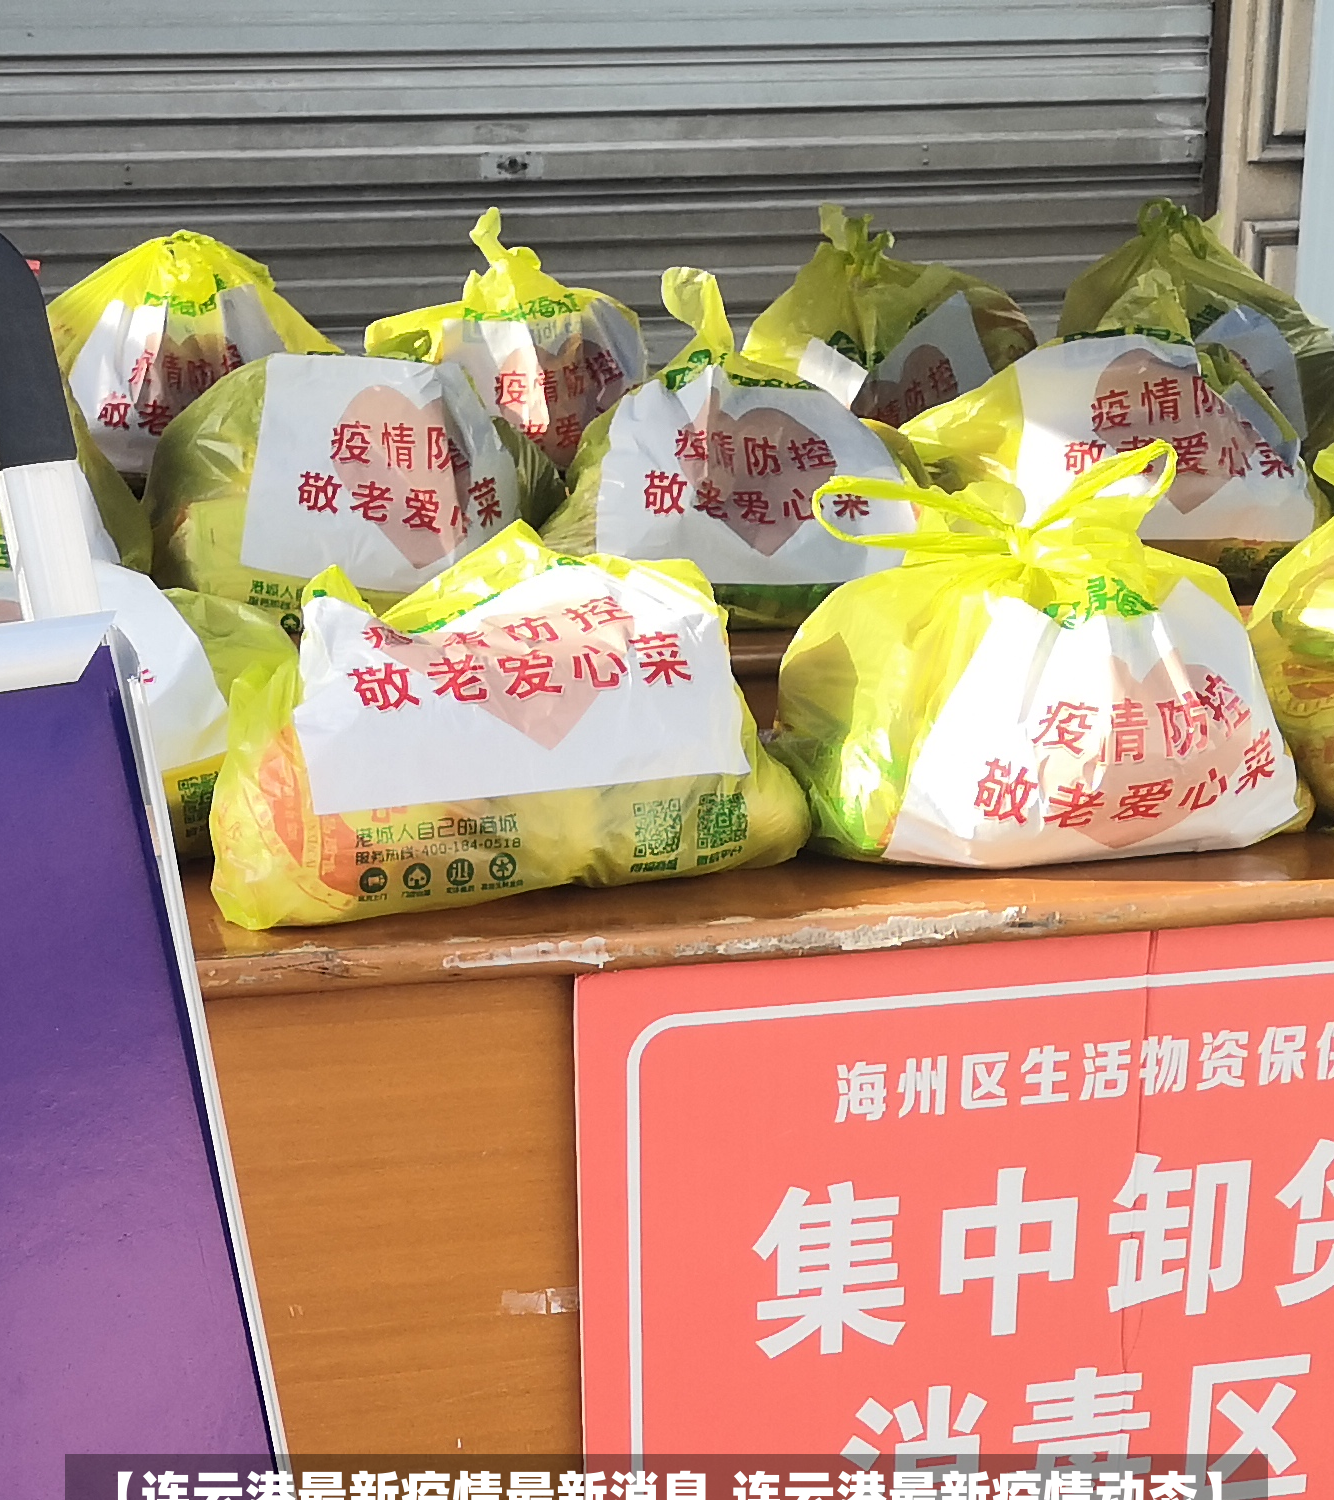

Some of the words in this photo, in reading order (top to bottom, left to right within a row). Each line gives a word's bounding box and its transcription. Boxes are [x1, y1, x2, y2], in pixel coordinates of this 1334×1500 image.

[346, 630, 693, 712] 敬老爱心菜
[1031, 672, 1252, 764] 疫情防控
[973, 726, 1277, 829] 敬老爱心菜
